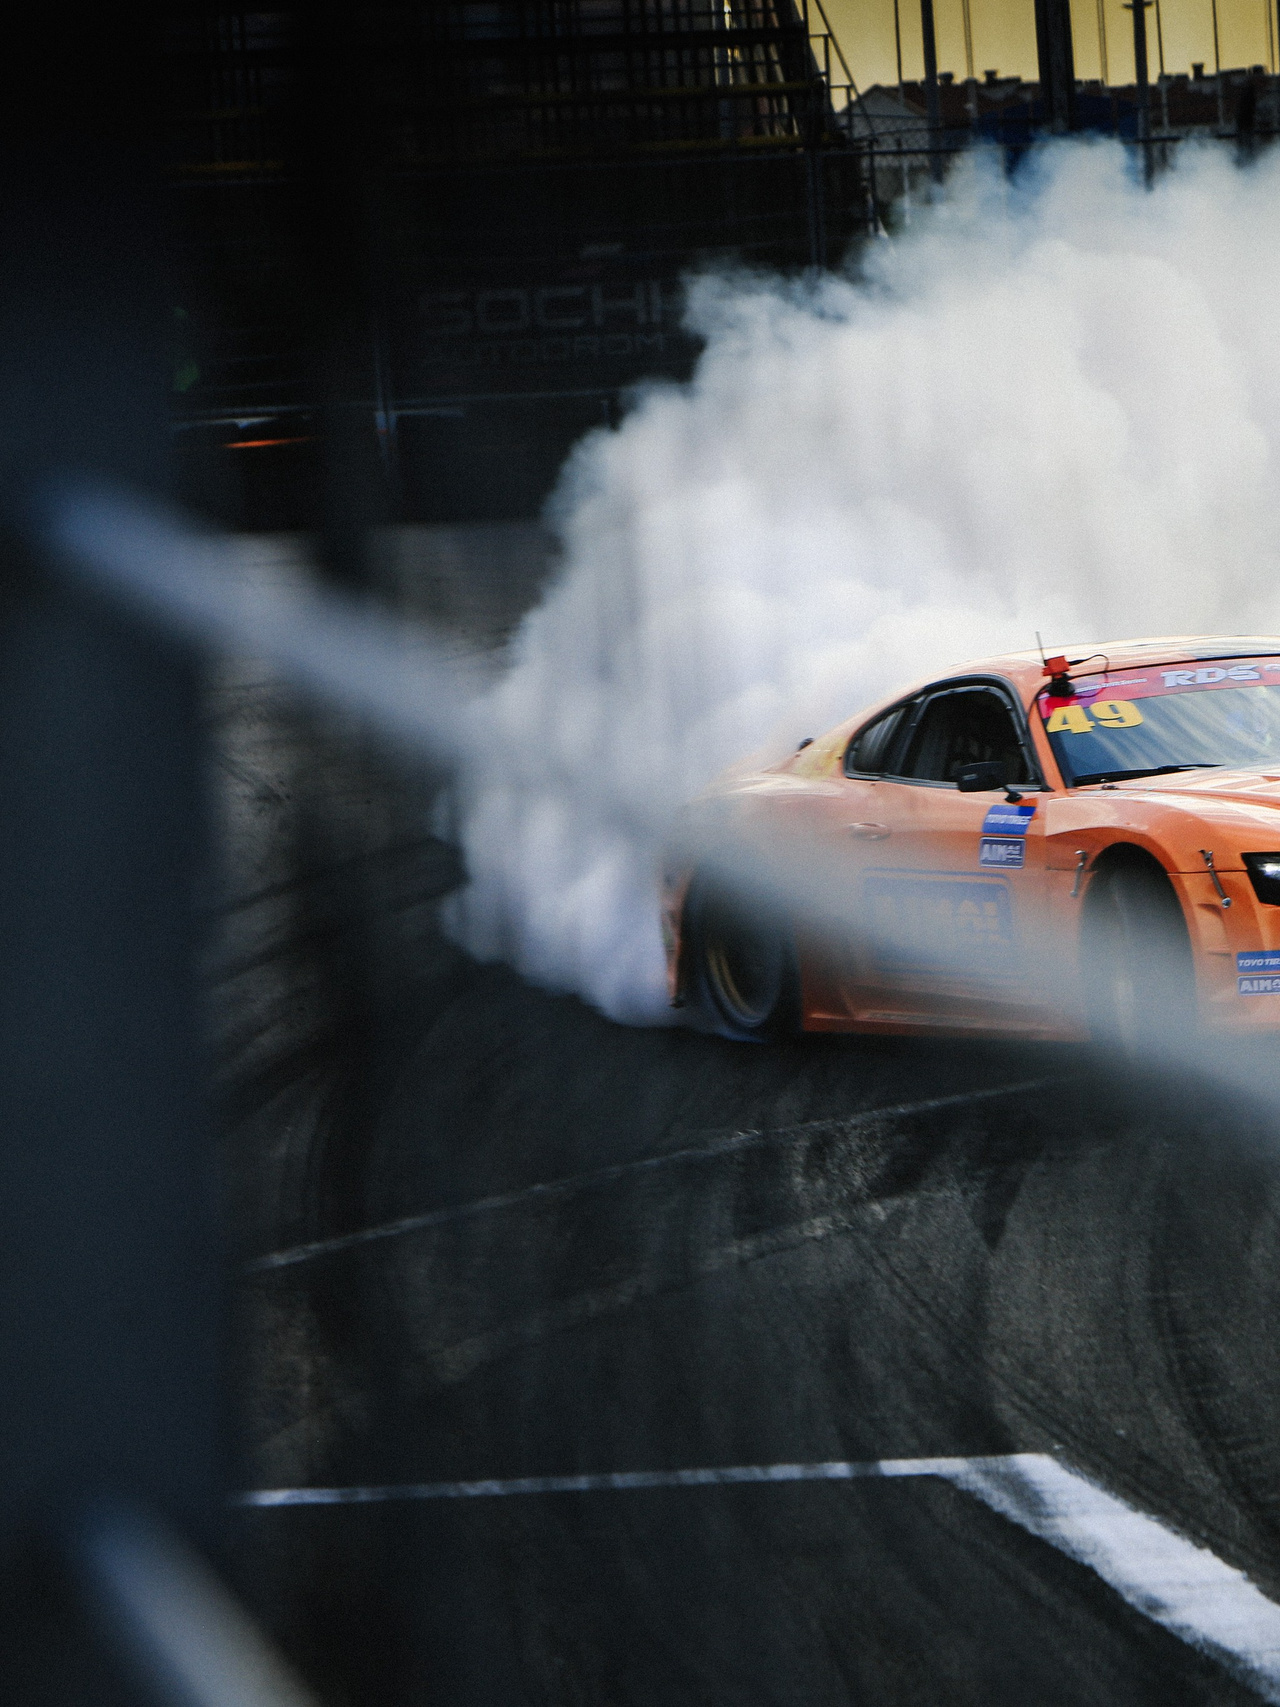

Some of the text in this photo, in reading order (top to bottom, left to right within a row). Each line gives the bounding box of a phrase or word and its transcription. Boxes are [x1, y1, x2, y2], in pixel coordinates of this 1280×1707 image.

[418, 280, 662, 336] SOCHI
[1160, 664, 1260, 688] RDS
[1046, 699, 1144, 734] 49
